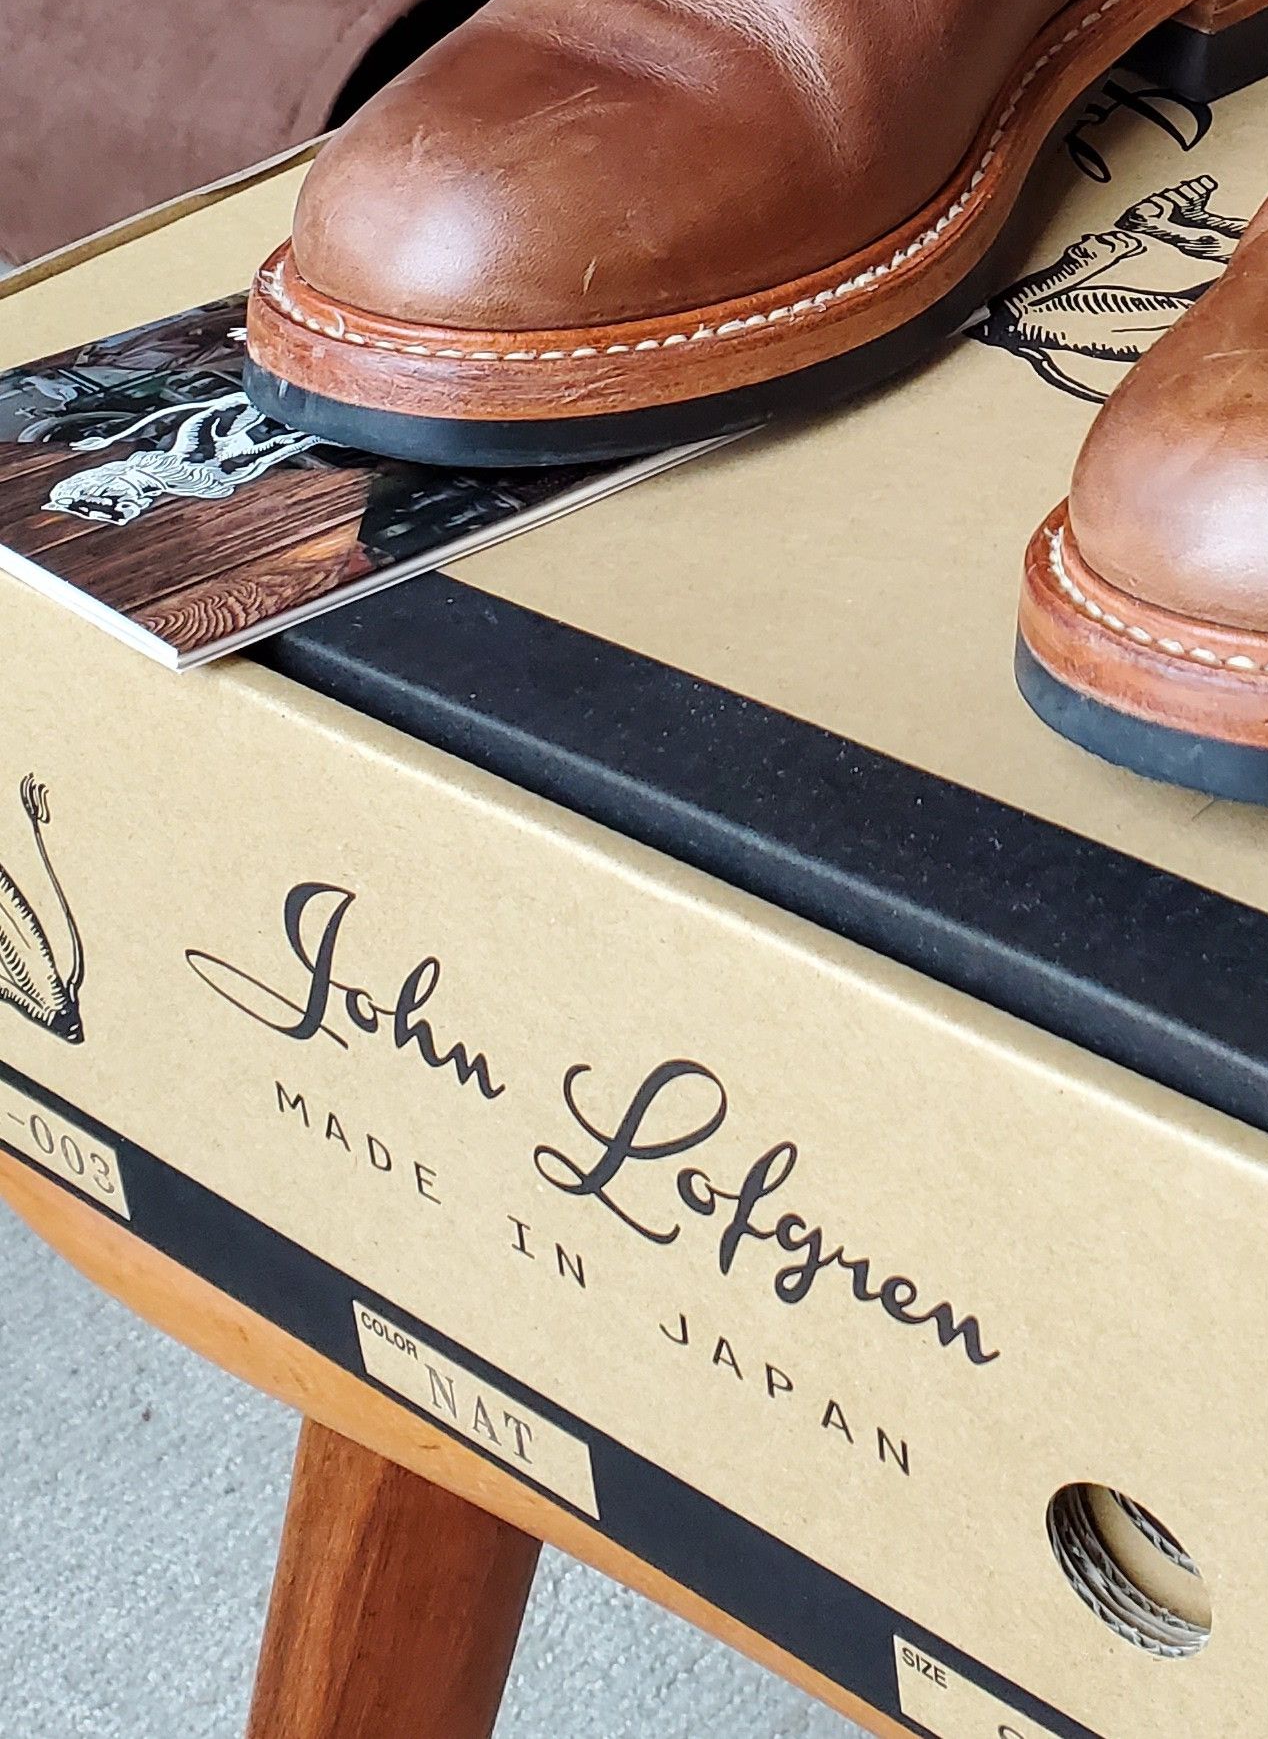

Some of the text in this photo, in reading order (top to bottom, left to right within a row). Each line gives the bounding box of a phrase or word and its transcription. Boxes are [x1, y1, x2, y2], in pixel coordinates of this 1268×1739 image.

[184, 881, 1000, 1365] John Lofgren
[274, 1080, 910, 1476] MADE IN JAPAN
[360, 1311, 418, 1360] COLOR
[424, 1363, 533, 1464] NAT
[902, 1647, 948, 1689] SIZE
